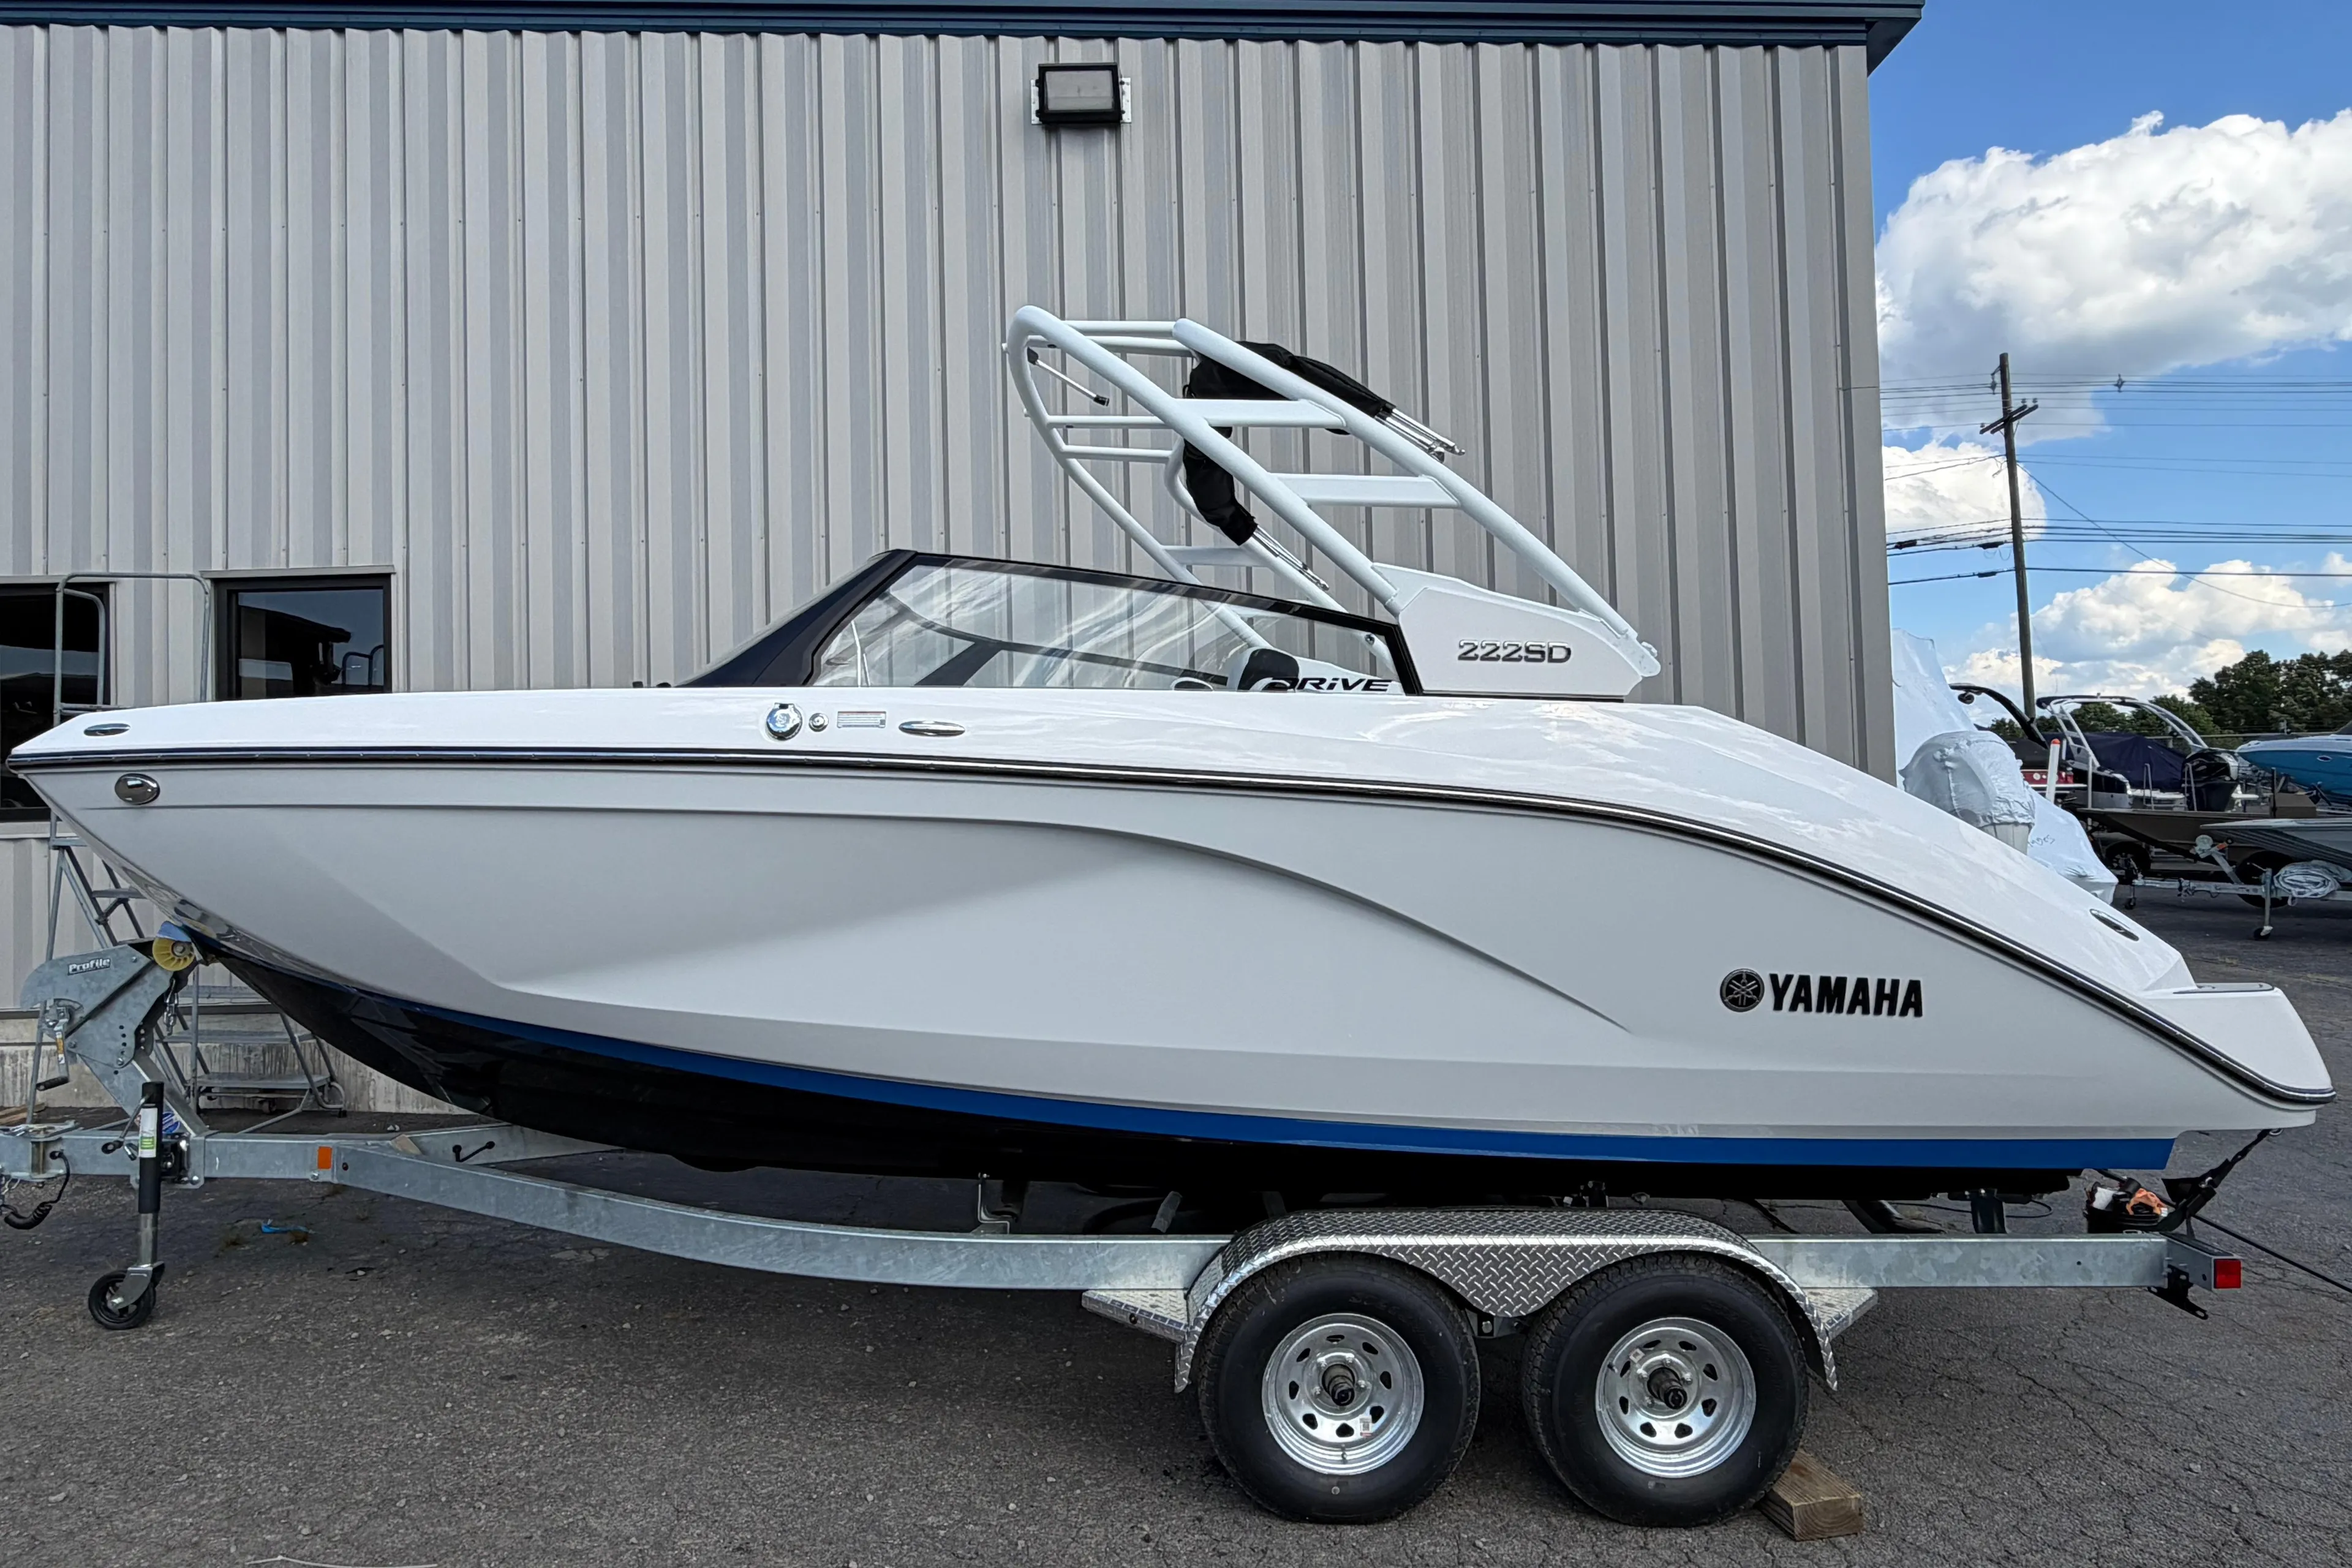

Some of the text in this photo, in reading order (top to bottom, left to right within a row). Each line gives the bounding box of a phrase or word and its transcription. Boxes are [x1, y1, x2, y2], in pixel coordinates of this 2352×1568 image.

[1458, 639, 1571, 663] 222SD
[69, 958, 110, 974] Profile
[1769, 973, 1923, 1017] YAMAHA
